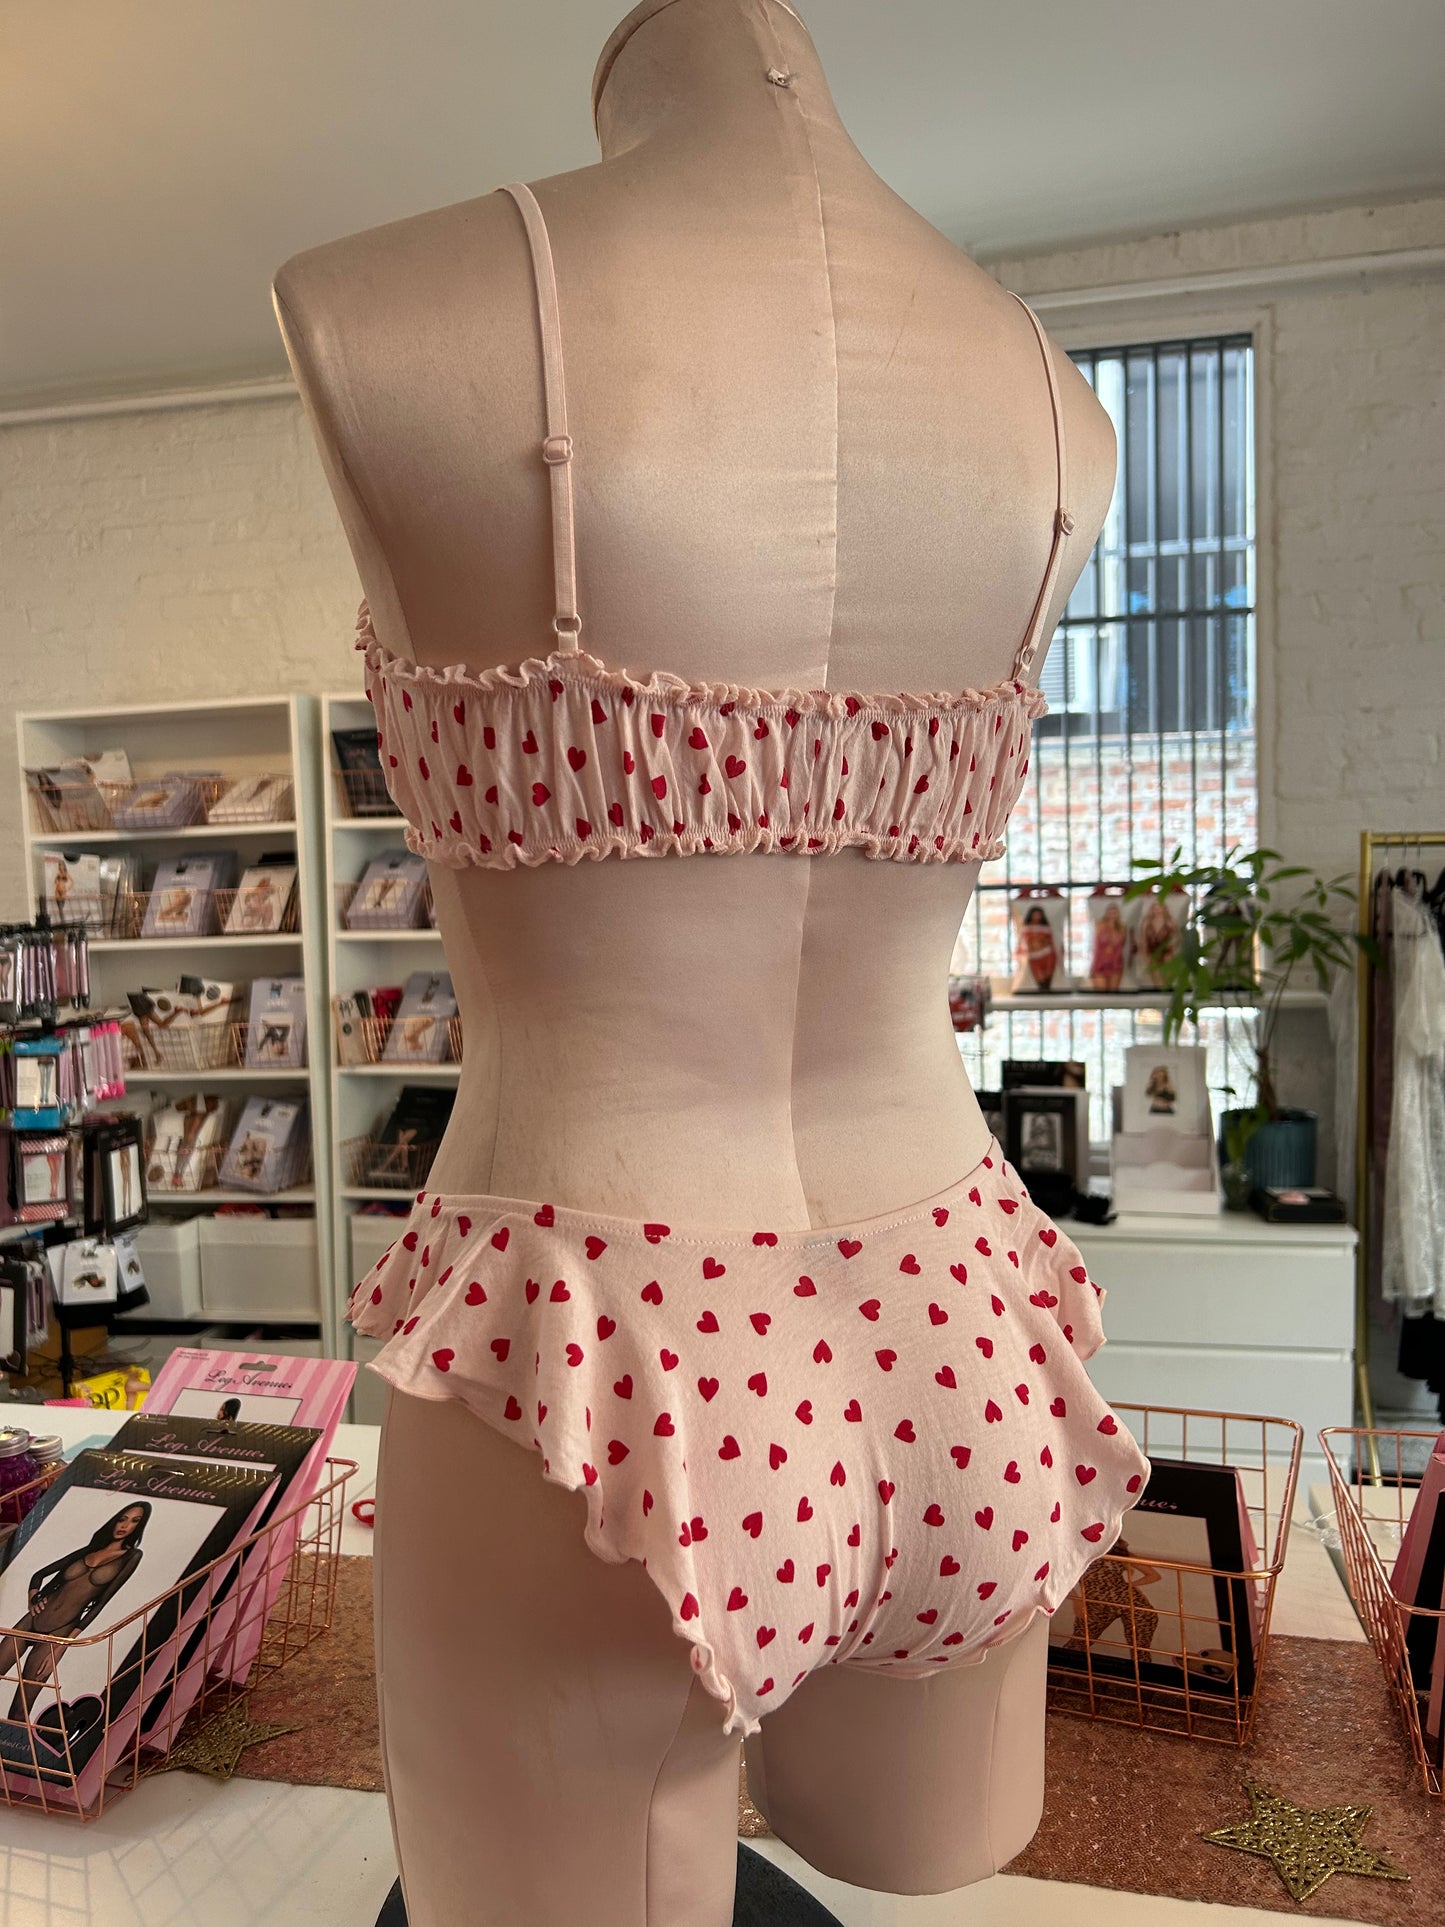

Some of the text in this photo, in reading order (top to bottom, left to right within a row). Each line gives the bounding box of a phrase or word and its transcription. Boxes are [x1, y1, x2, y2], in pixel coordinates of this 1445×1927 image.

[205, 1369, 237, 1391] Leg
[145, 1433, 186, 1455] Leg
[94, 1468, 138, 1496] Leg
